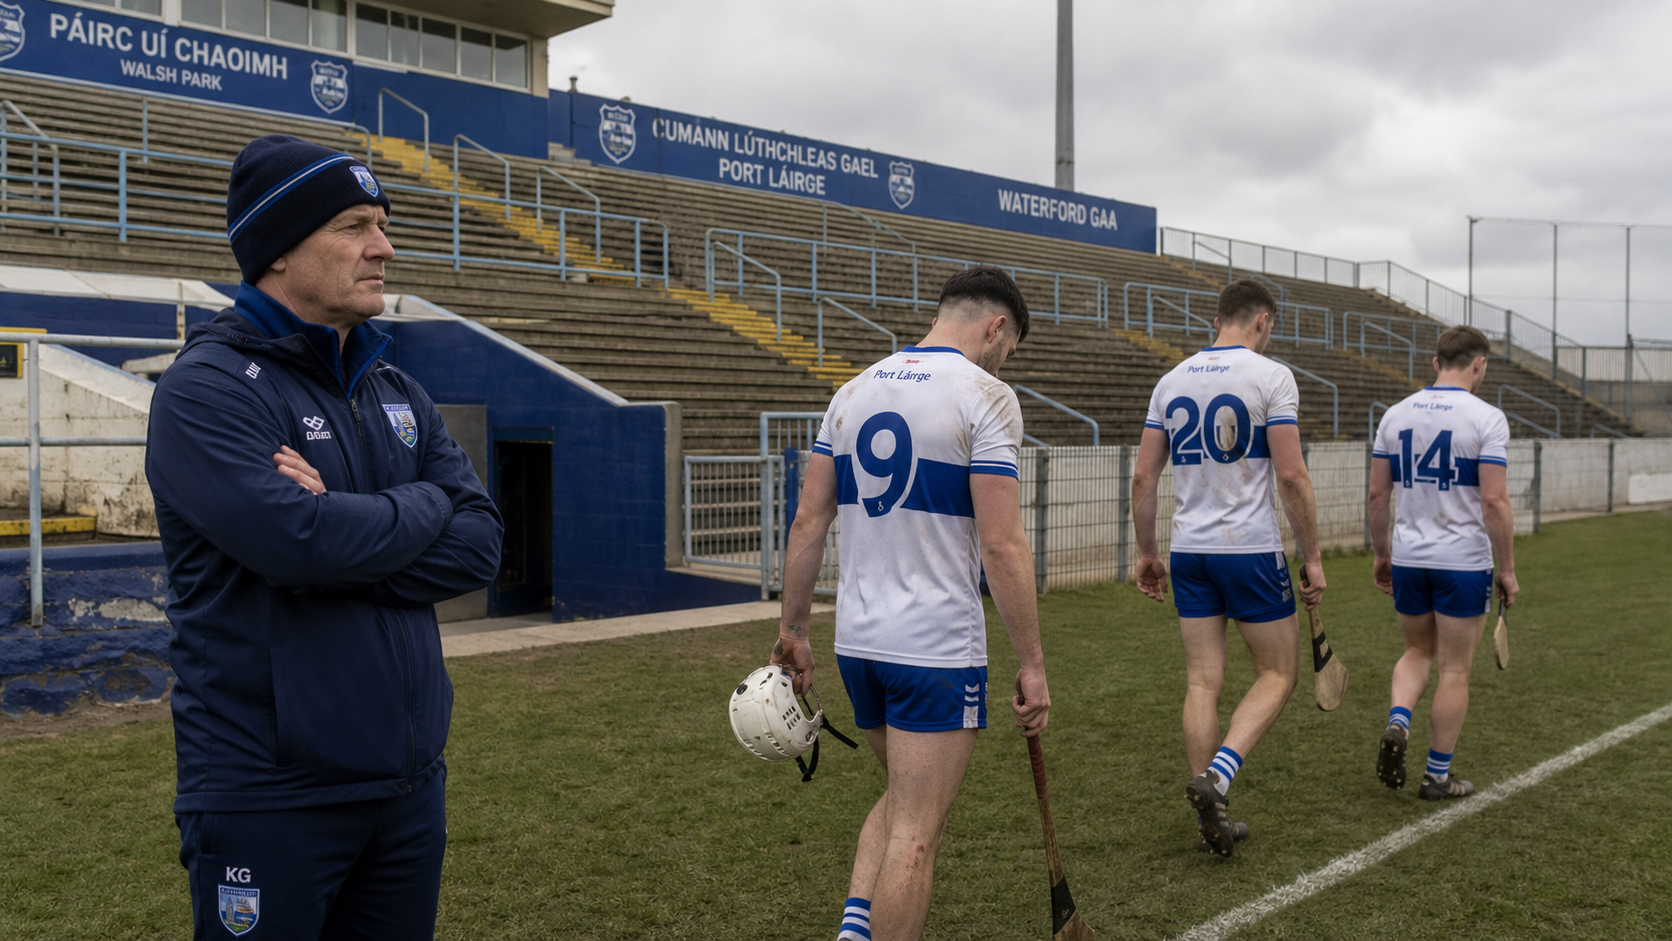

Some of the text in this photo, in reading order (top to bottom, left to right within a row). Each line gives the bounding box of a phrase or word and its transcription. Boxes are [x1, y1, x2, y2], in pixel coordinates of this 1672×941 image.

[50, 11, 288, 80] PÁIRC UÍ CHAOIMH
[120, 58, 222, 91] WALSH PARK
[652, 116, 879, 179] CUMANN LÚTHCHLEAS GAEL
[719, 158, 826, 196] PORT LÁIRGE
[998, 189, 1118, 231] WATERFORD GAA
[1165, 393, 1251, 466] 20
[1398, 428, 1456, 492] 14
[856, 411, 913, 518] 9
[226, 866, 252, 884] KG
